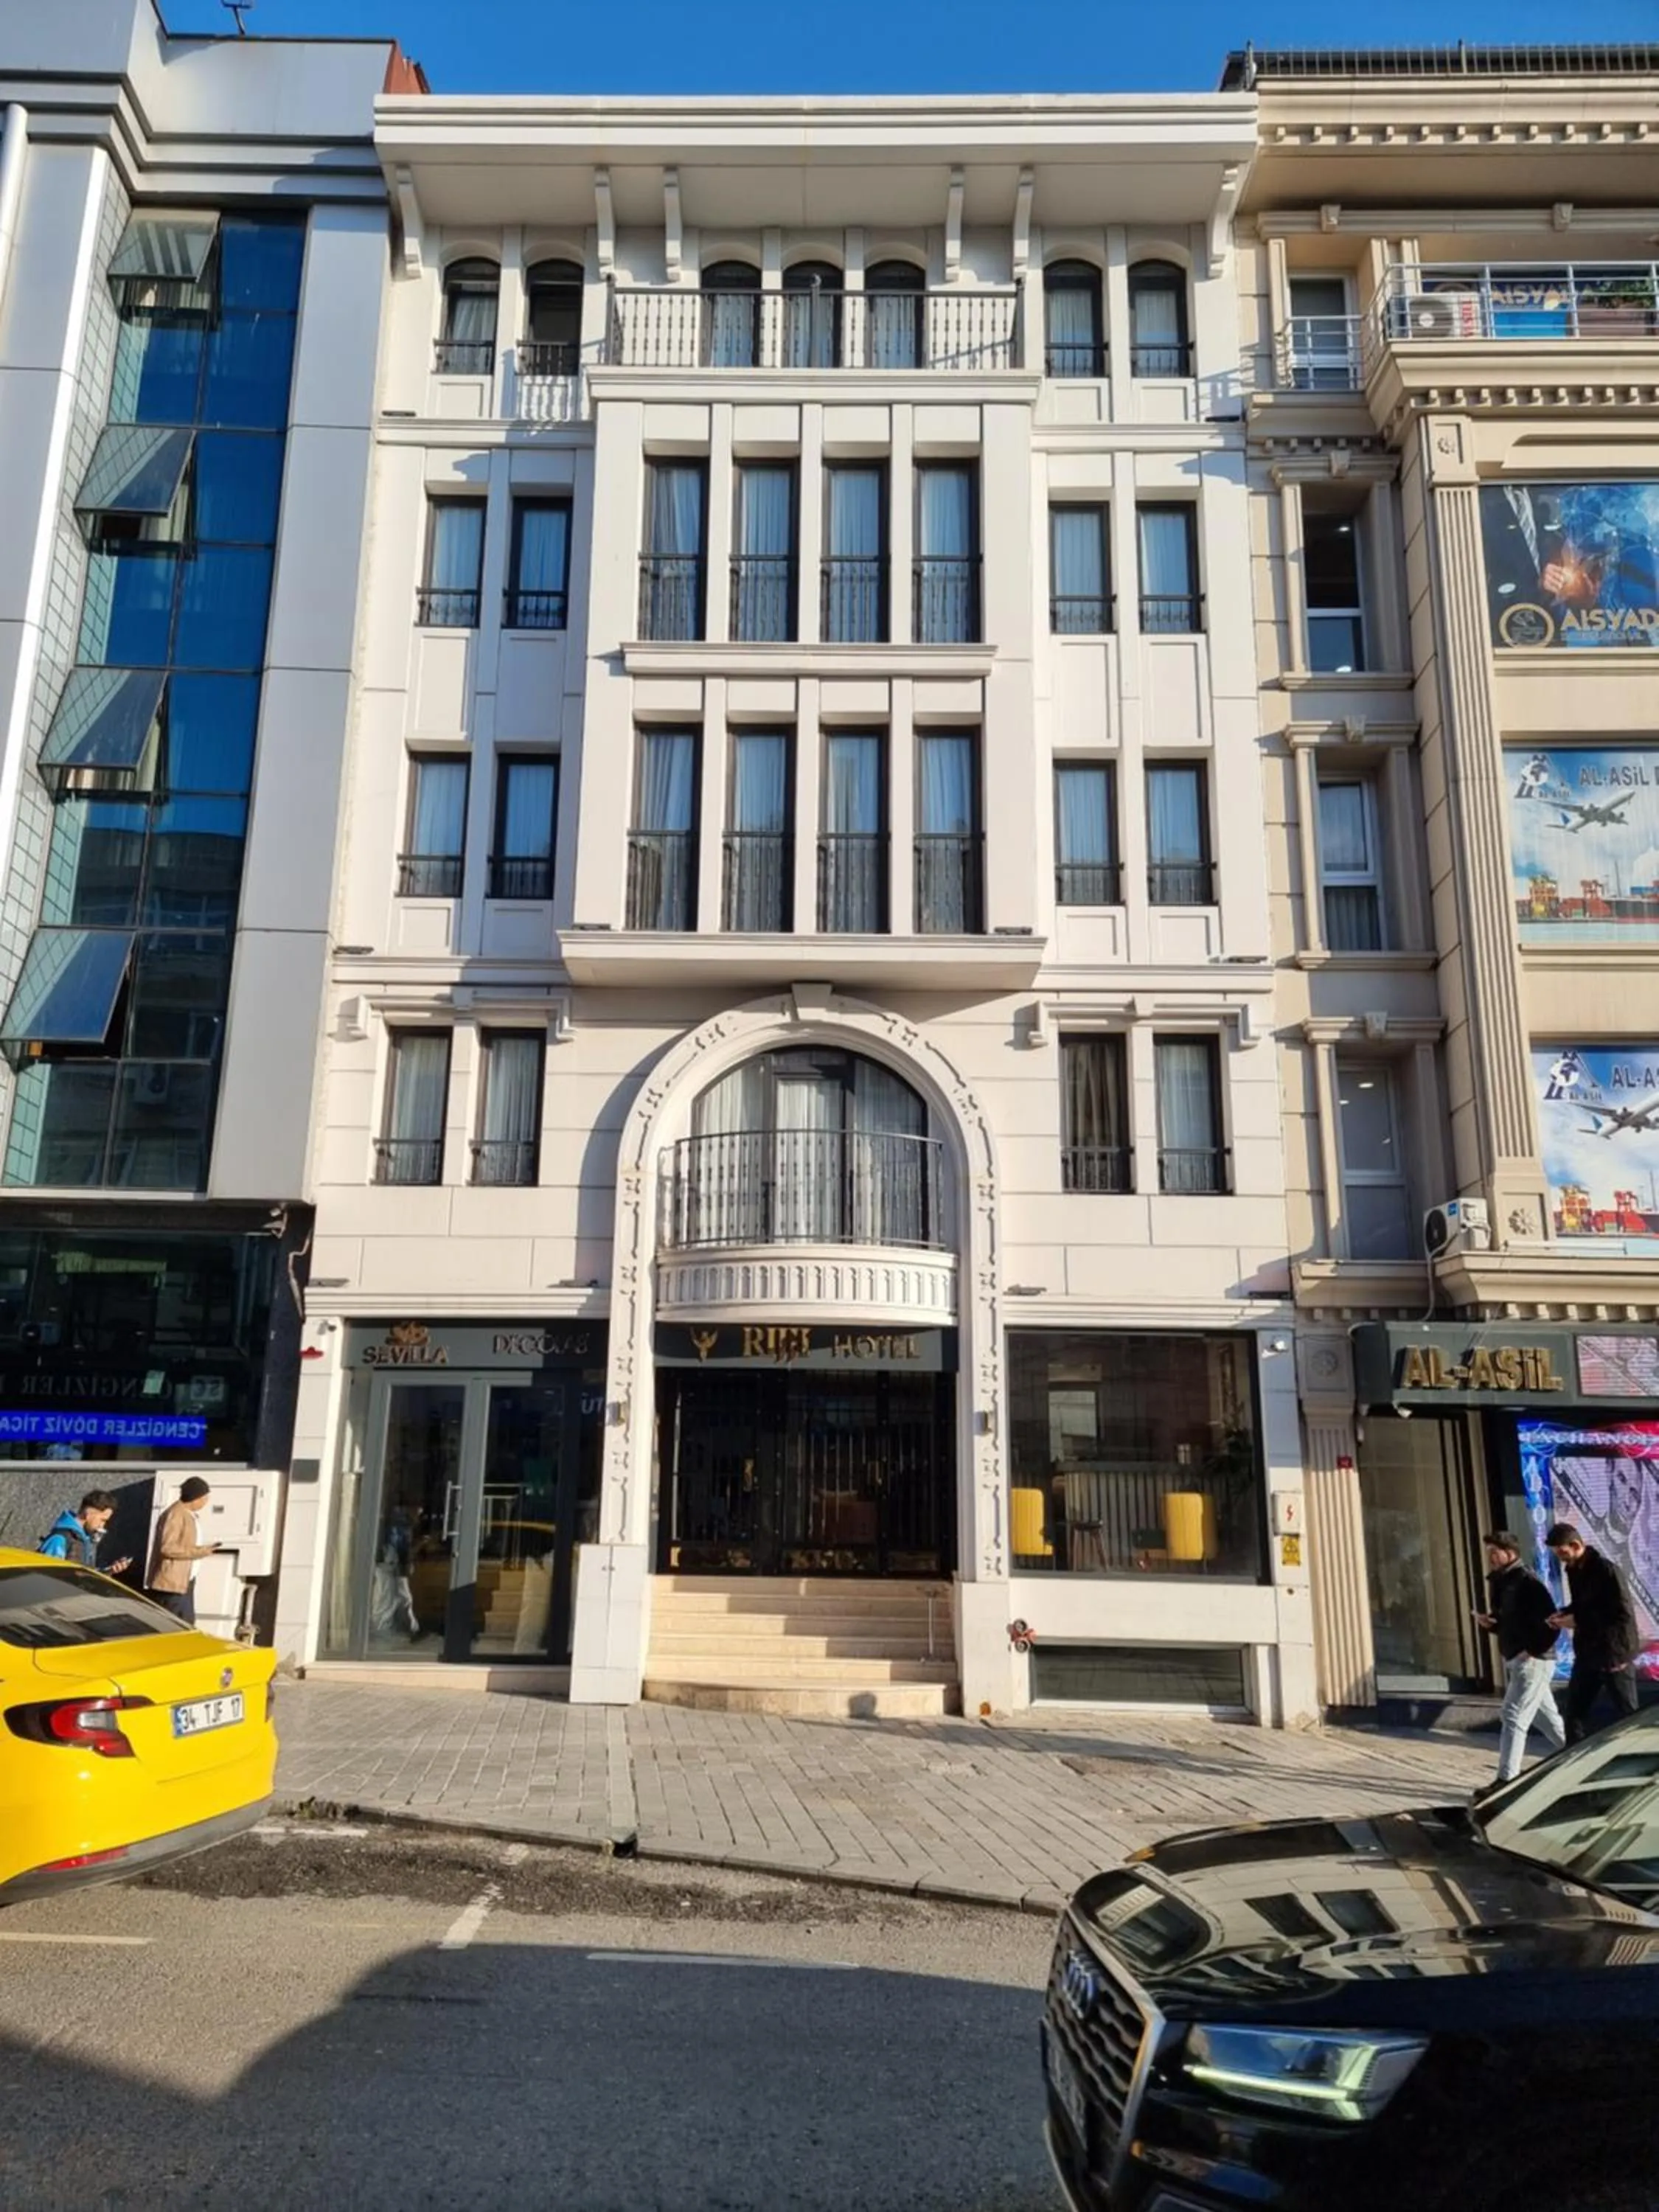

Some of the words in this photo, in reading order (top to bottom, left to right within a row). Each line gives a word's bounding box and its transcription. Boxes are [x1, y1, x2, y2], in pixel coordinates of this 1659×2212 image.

[1612, 1067, 1659, 1088] AL-A
[362, 1345, 450, 1365] SEVILLA
[831, 1334, 921, 1360] HOTEL
